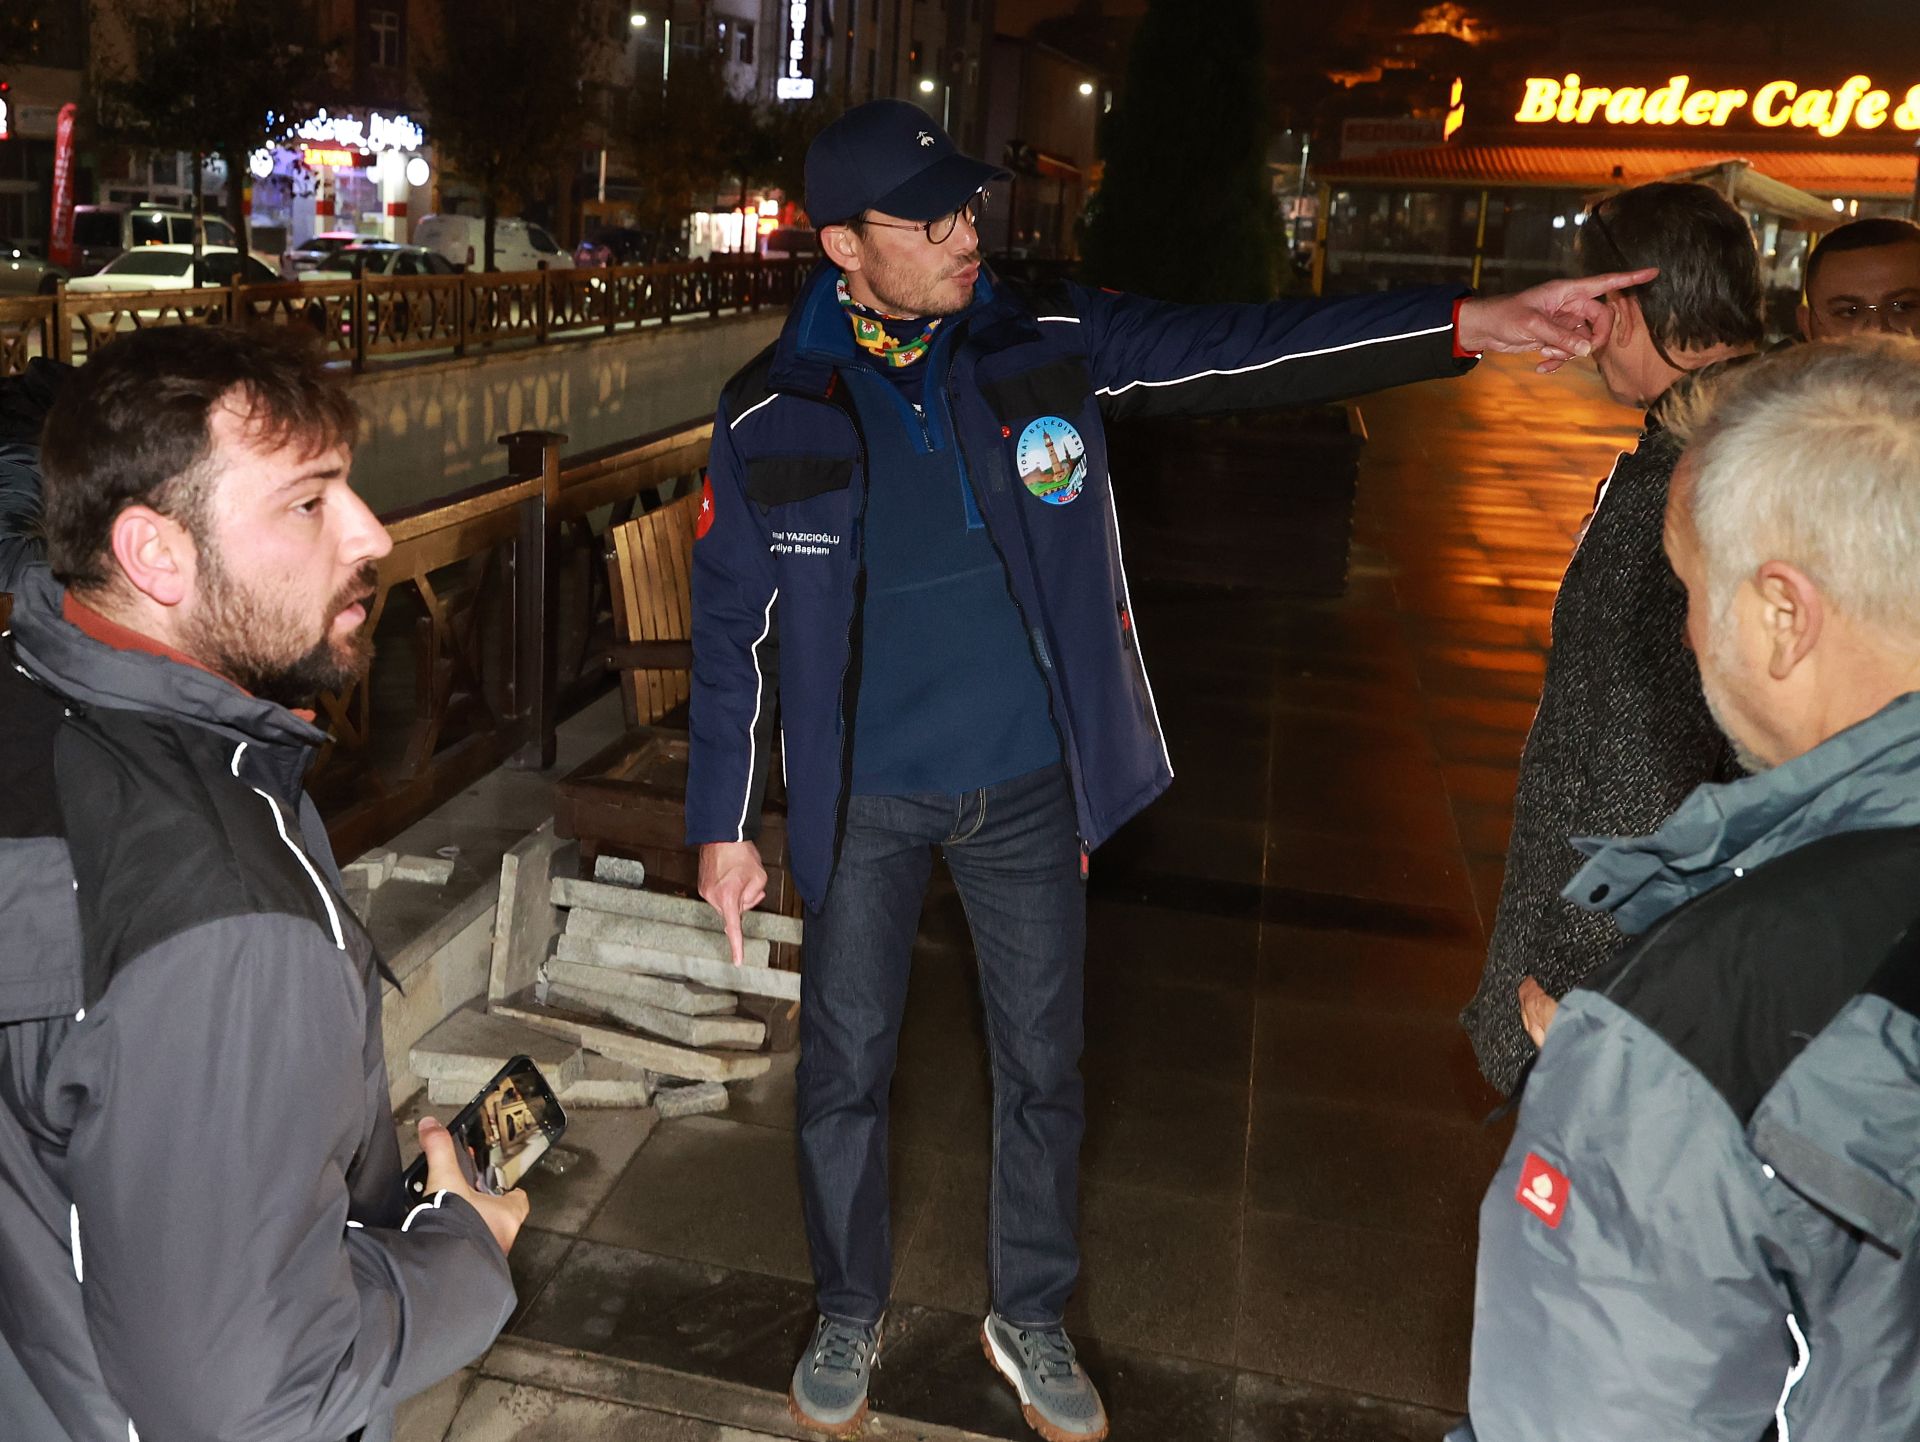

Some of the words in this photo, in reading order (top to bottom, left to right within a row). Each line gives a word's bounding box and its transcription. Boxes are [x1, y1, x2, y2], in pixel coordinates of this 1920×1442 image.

[789, 0, 807, 77] OTEL
[1514, 73, 1748, 126] Birader
[1752, 74, 1891, 138] Cafe
[1020, 438, 1029, 472] TOKAT
[786, 532, 840, 545] YAZICIOĞLU
[794, 544, 830, 556] Başkanı
